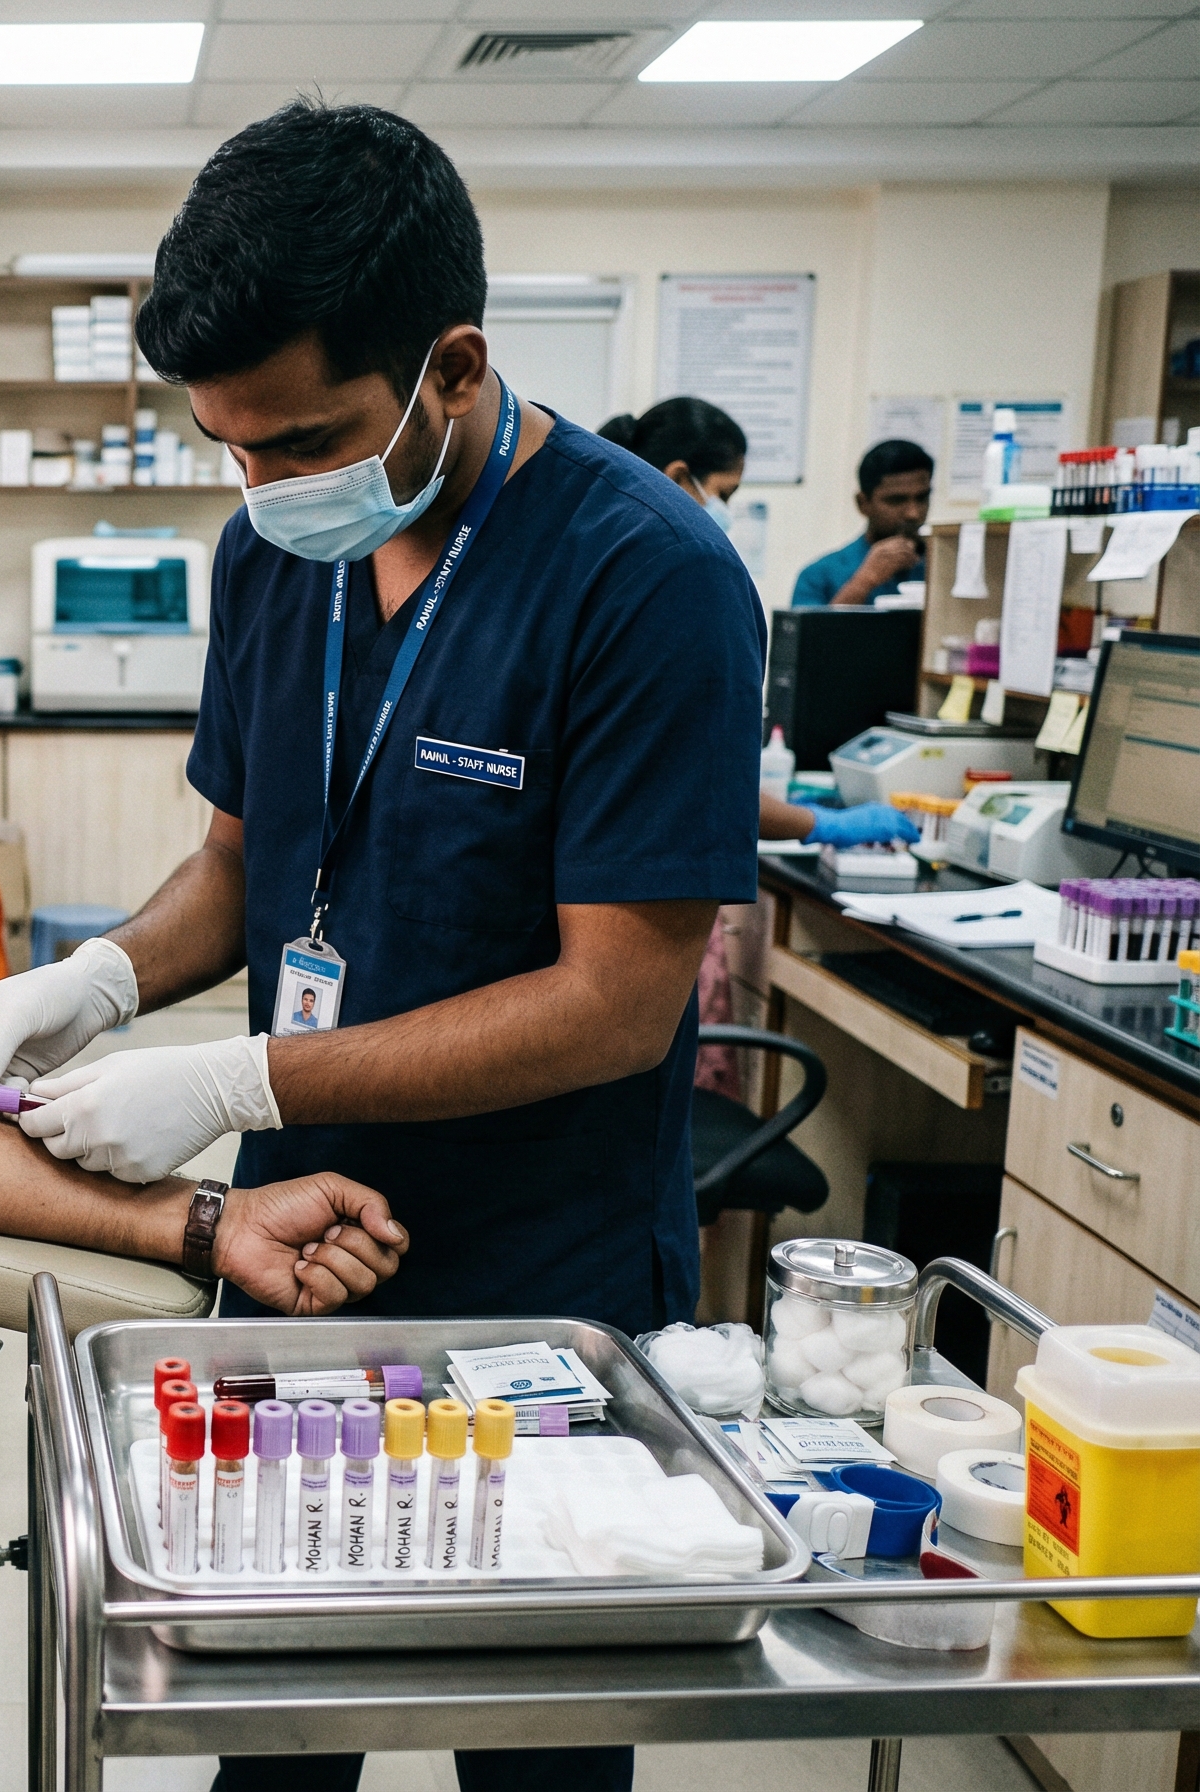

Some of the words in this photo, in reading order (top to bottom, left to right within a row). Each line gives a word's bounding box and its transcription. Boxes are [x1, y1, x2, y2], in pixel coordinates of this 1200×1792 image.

[458, 756, 484, 771] STAFF
[486, 762, 518, 778] NURSE
[306, 1498, 323, 1513] R.
[348, 1492, 367, 1508] R.
[396, 1493, 413, 1509] R.
[305, 1520, 322, 1571] MOHAN
[348, 1515, 365, 1567] MOHAN
[394, 1517, 412, 1569] MOHAN
